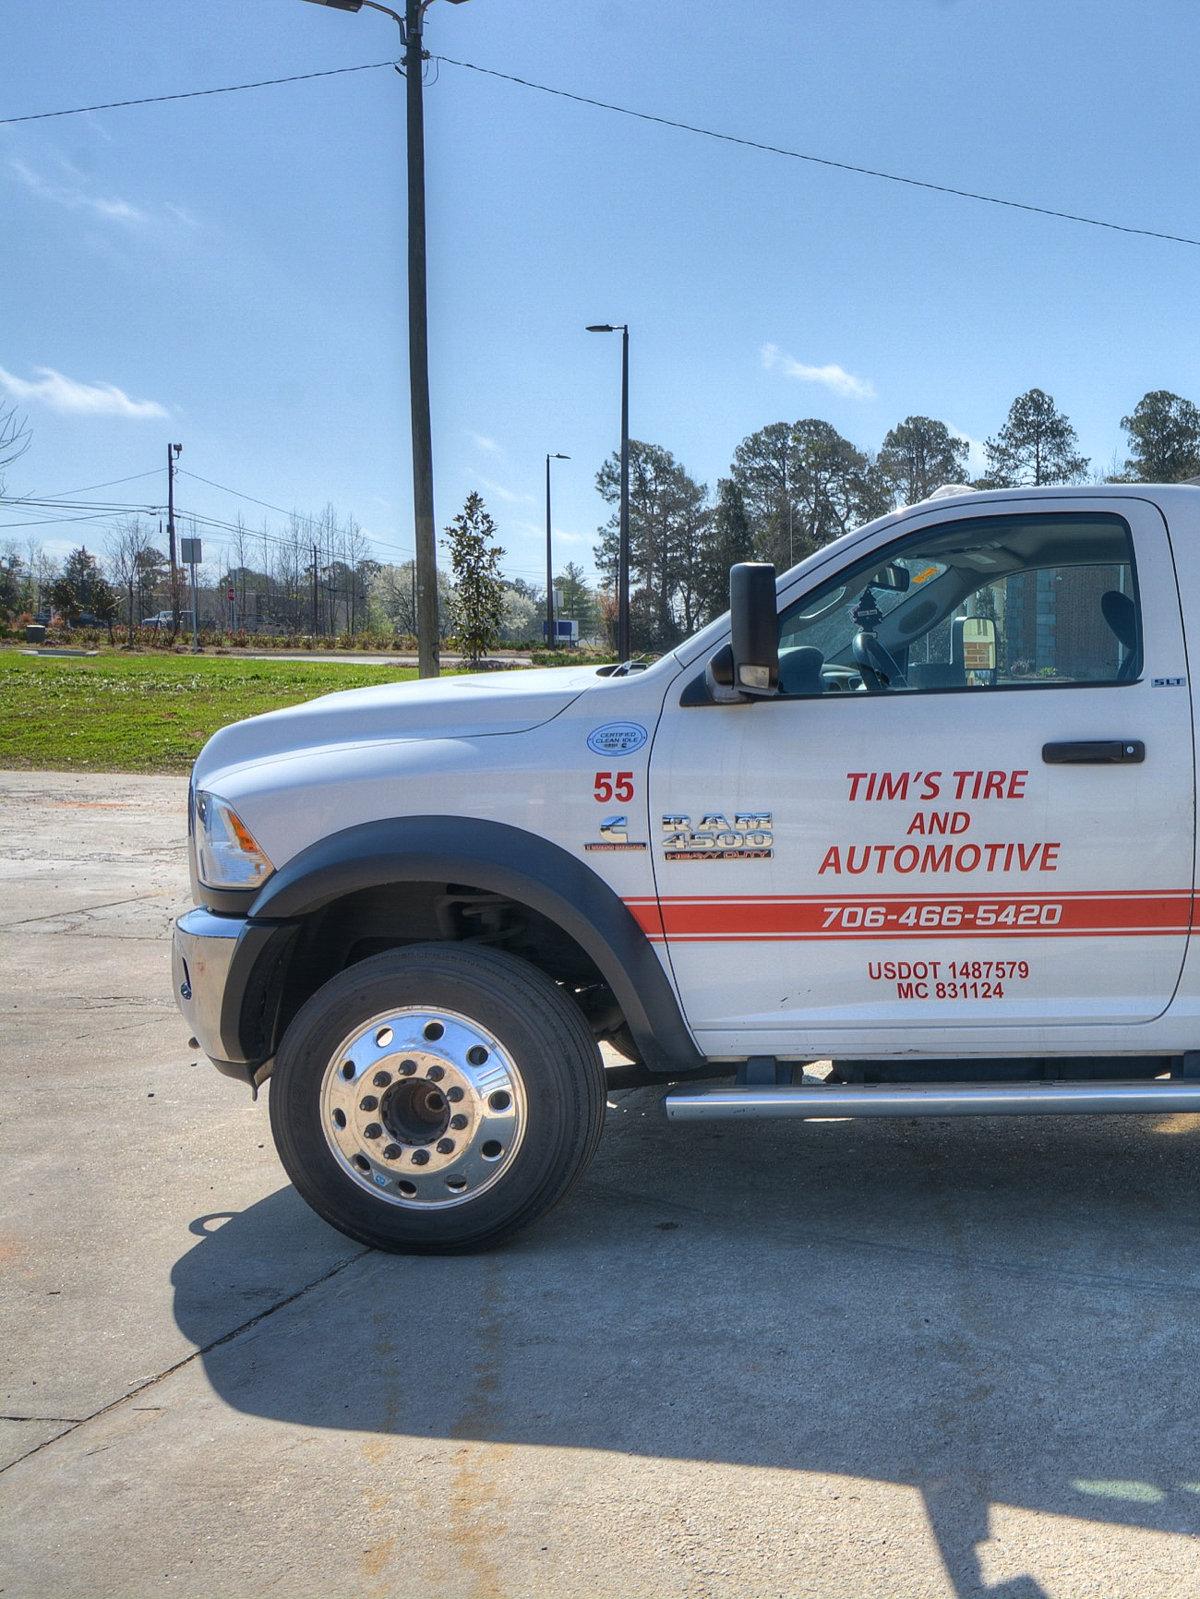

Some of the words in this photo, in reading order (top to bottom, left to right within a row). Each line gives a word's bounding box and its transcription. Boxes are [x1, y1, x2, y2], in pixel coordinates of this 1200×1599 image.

[593, 771, 635, 804] 55
[847, 771, 942, 801] TIM'S
[953, 770, 1029, 799] TIRE
[662, 812, 773, 832] RAM
[907, 811, 972, 835] AND
[661, 830, 774, 849] 4500
[666, 850, 721, 860] HEAVY
[723, 849, 770, 859] DUTY
[818, 842, 1061, 876] AUTOMOTIVE
[822, 904, 1063, 928] 706-466-5420
[867, 961, 942, 980] USDOT
[948, 961, 1030, 980] 1487579
[896, 982, 929, 999] MC
[935, 981, 1005, 999] 831124
